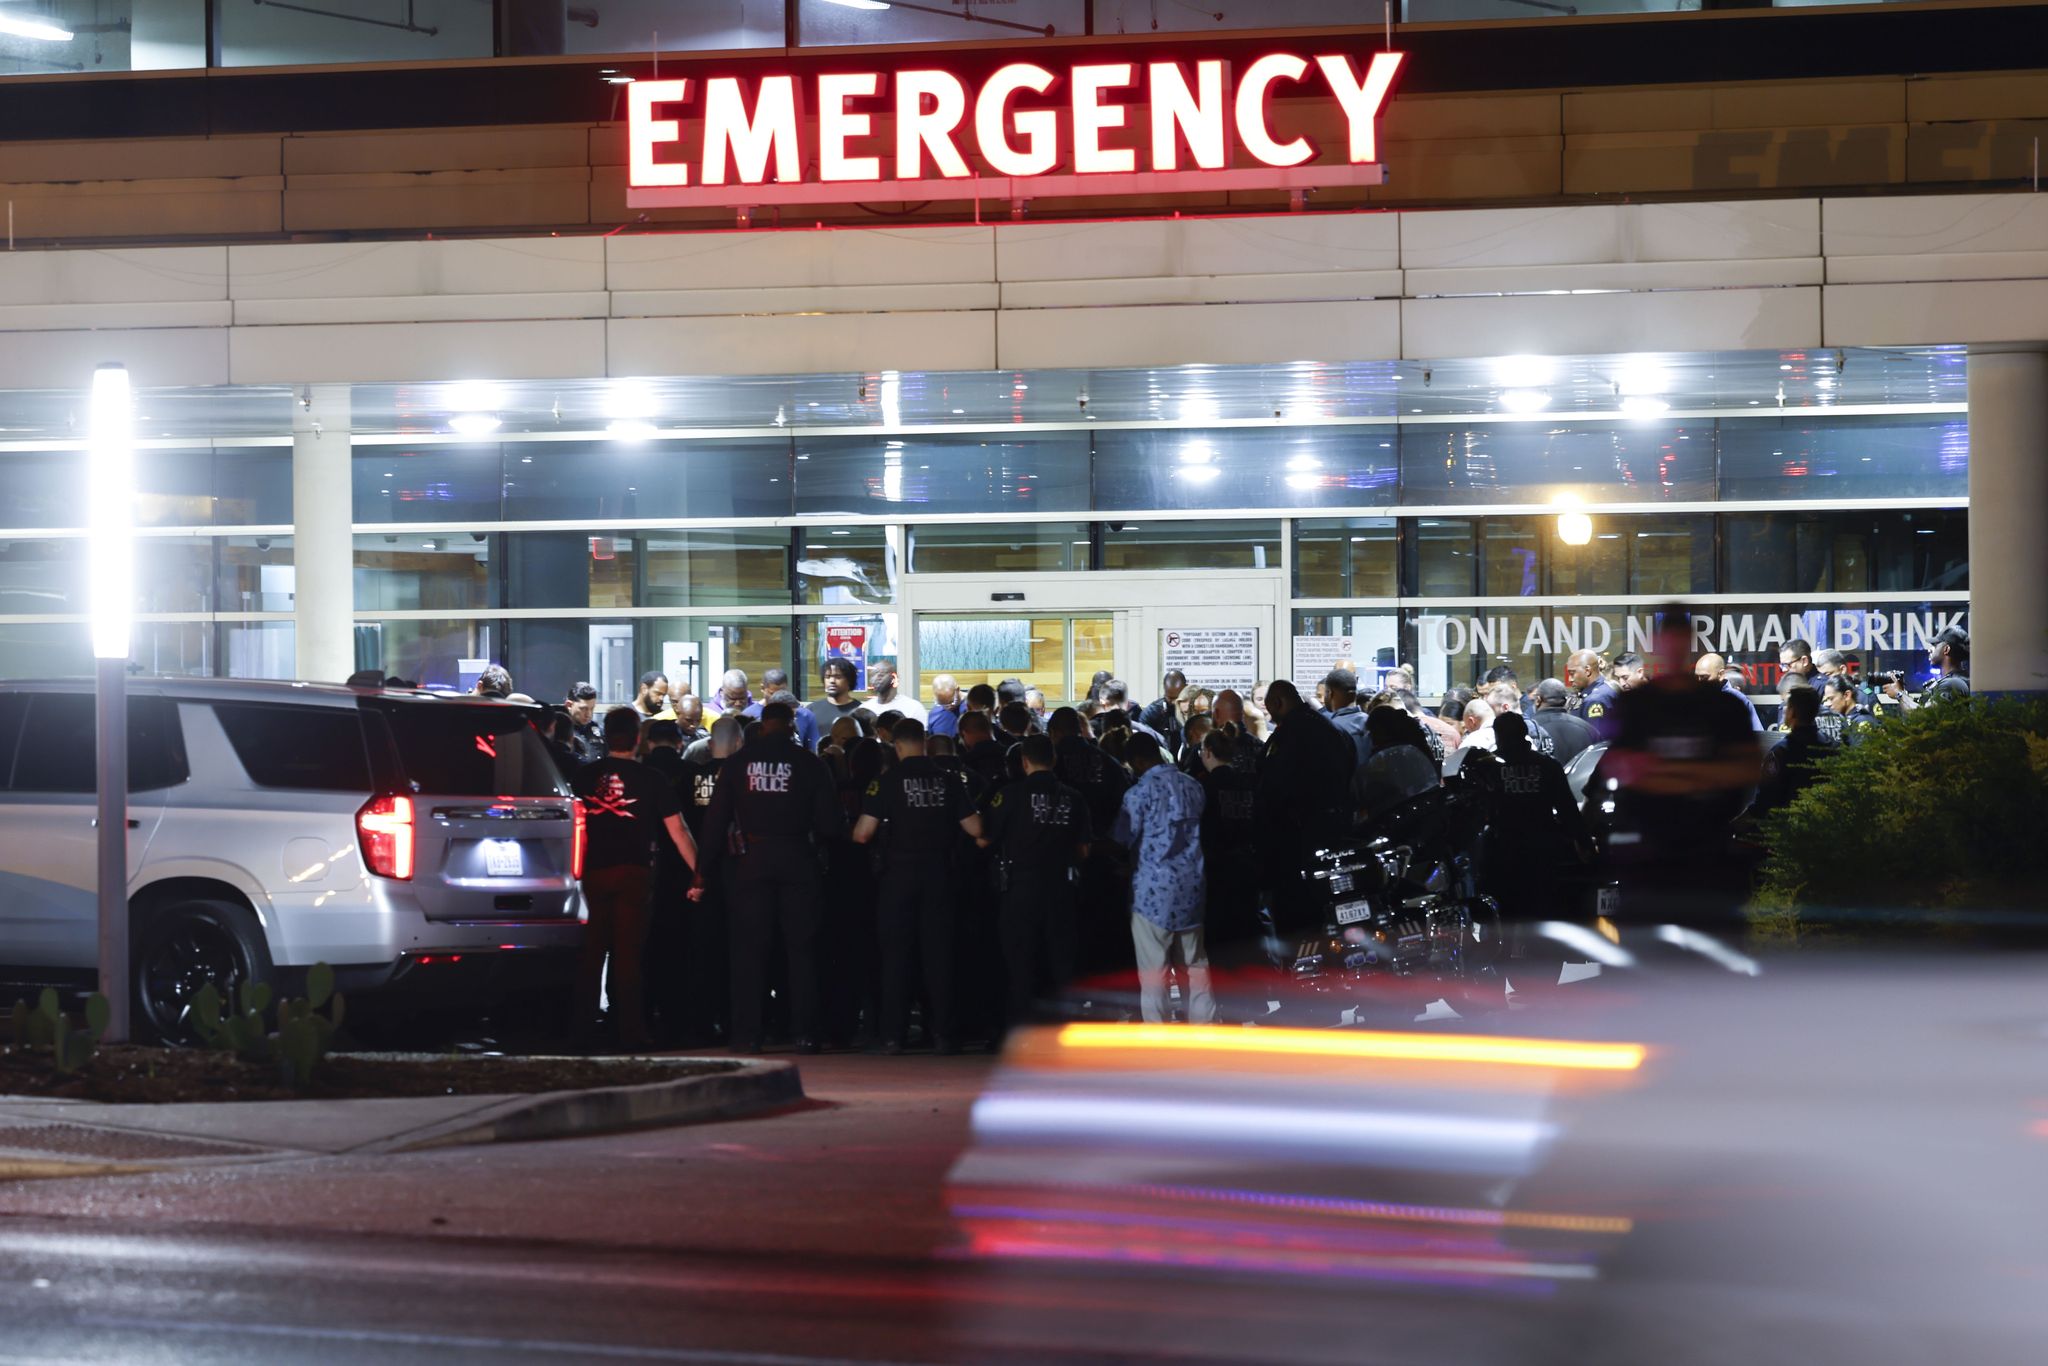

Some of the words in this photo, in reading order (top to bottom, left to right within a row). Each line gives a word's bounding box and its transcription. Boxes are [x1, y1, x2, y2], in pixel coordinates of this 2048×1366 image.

[627, 52, 1404, 187] EMERGENCY
[1411, 617, 1509, 656] TONI
[1522, 616, 1611, 654] AND
[1626, 613, 1817, 653] NRMAN
[747, 762, 792, 777] DALLAS
[749, 776, 789, 792] POLICE
[903, 778, 946, 794] DALLAS
[907, 792, 945, 808] POLICE
